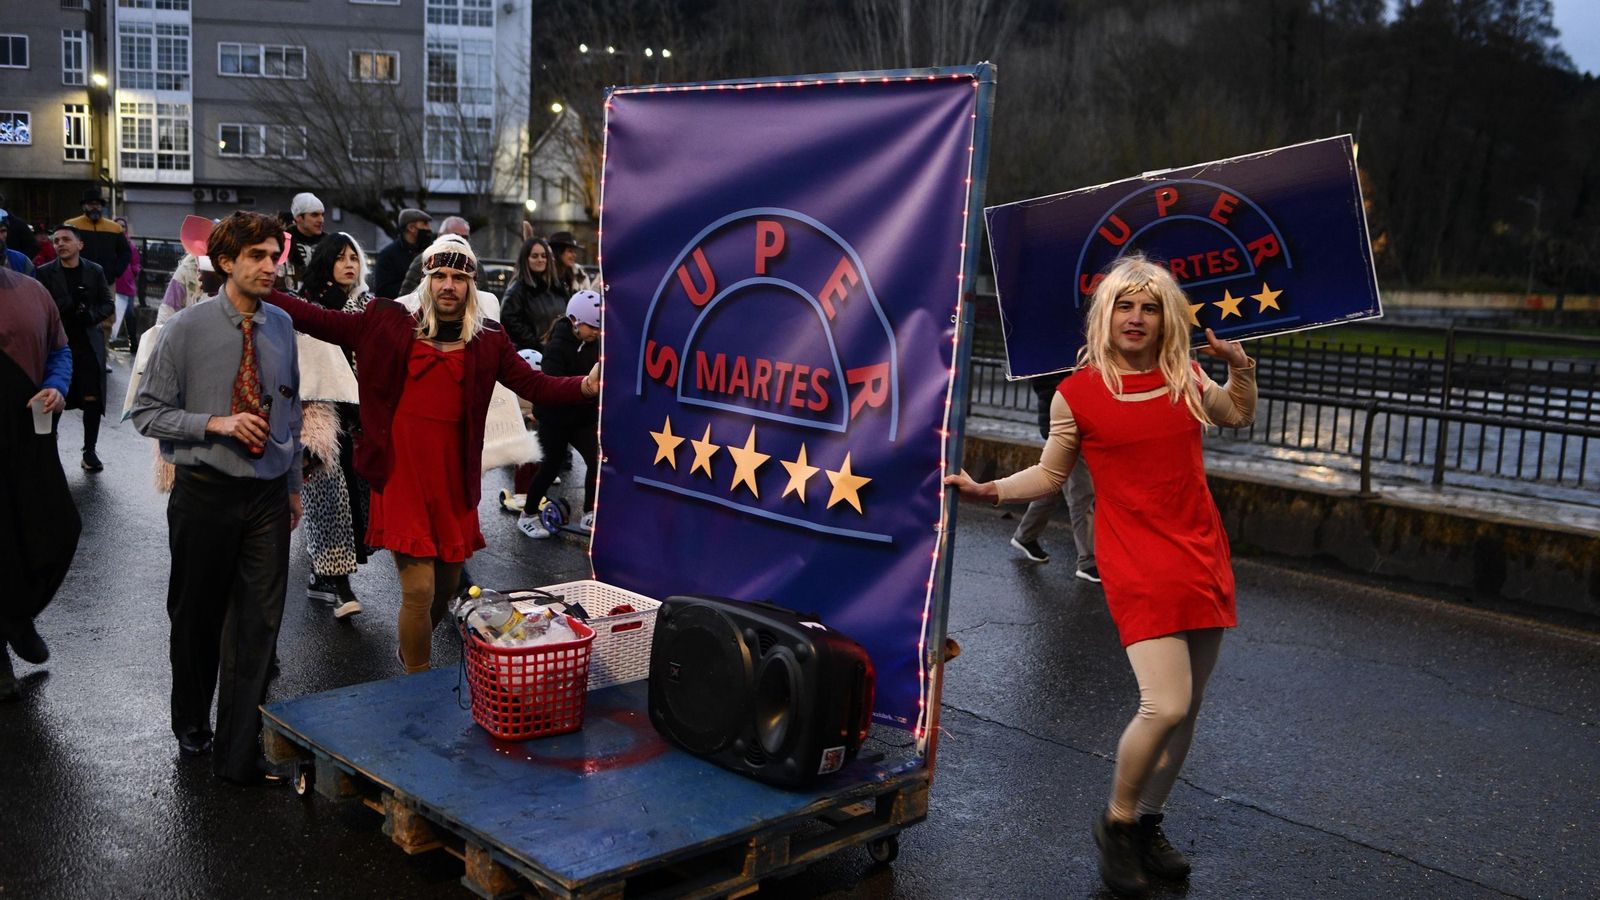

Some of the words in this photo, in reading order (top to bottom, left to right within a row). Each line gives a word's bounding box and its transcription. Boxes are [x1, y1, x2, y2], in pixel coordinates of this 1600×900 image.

[1154, 248, 1240, 280] RTES
[645, 220, 889, 421] SUPER
[695, 350, 831, 412] MARTES
